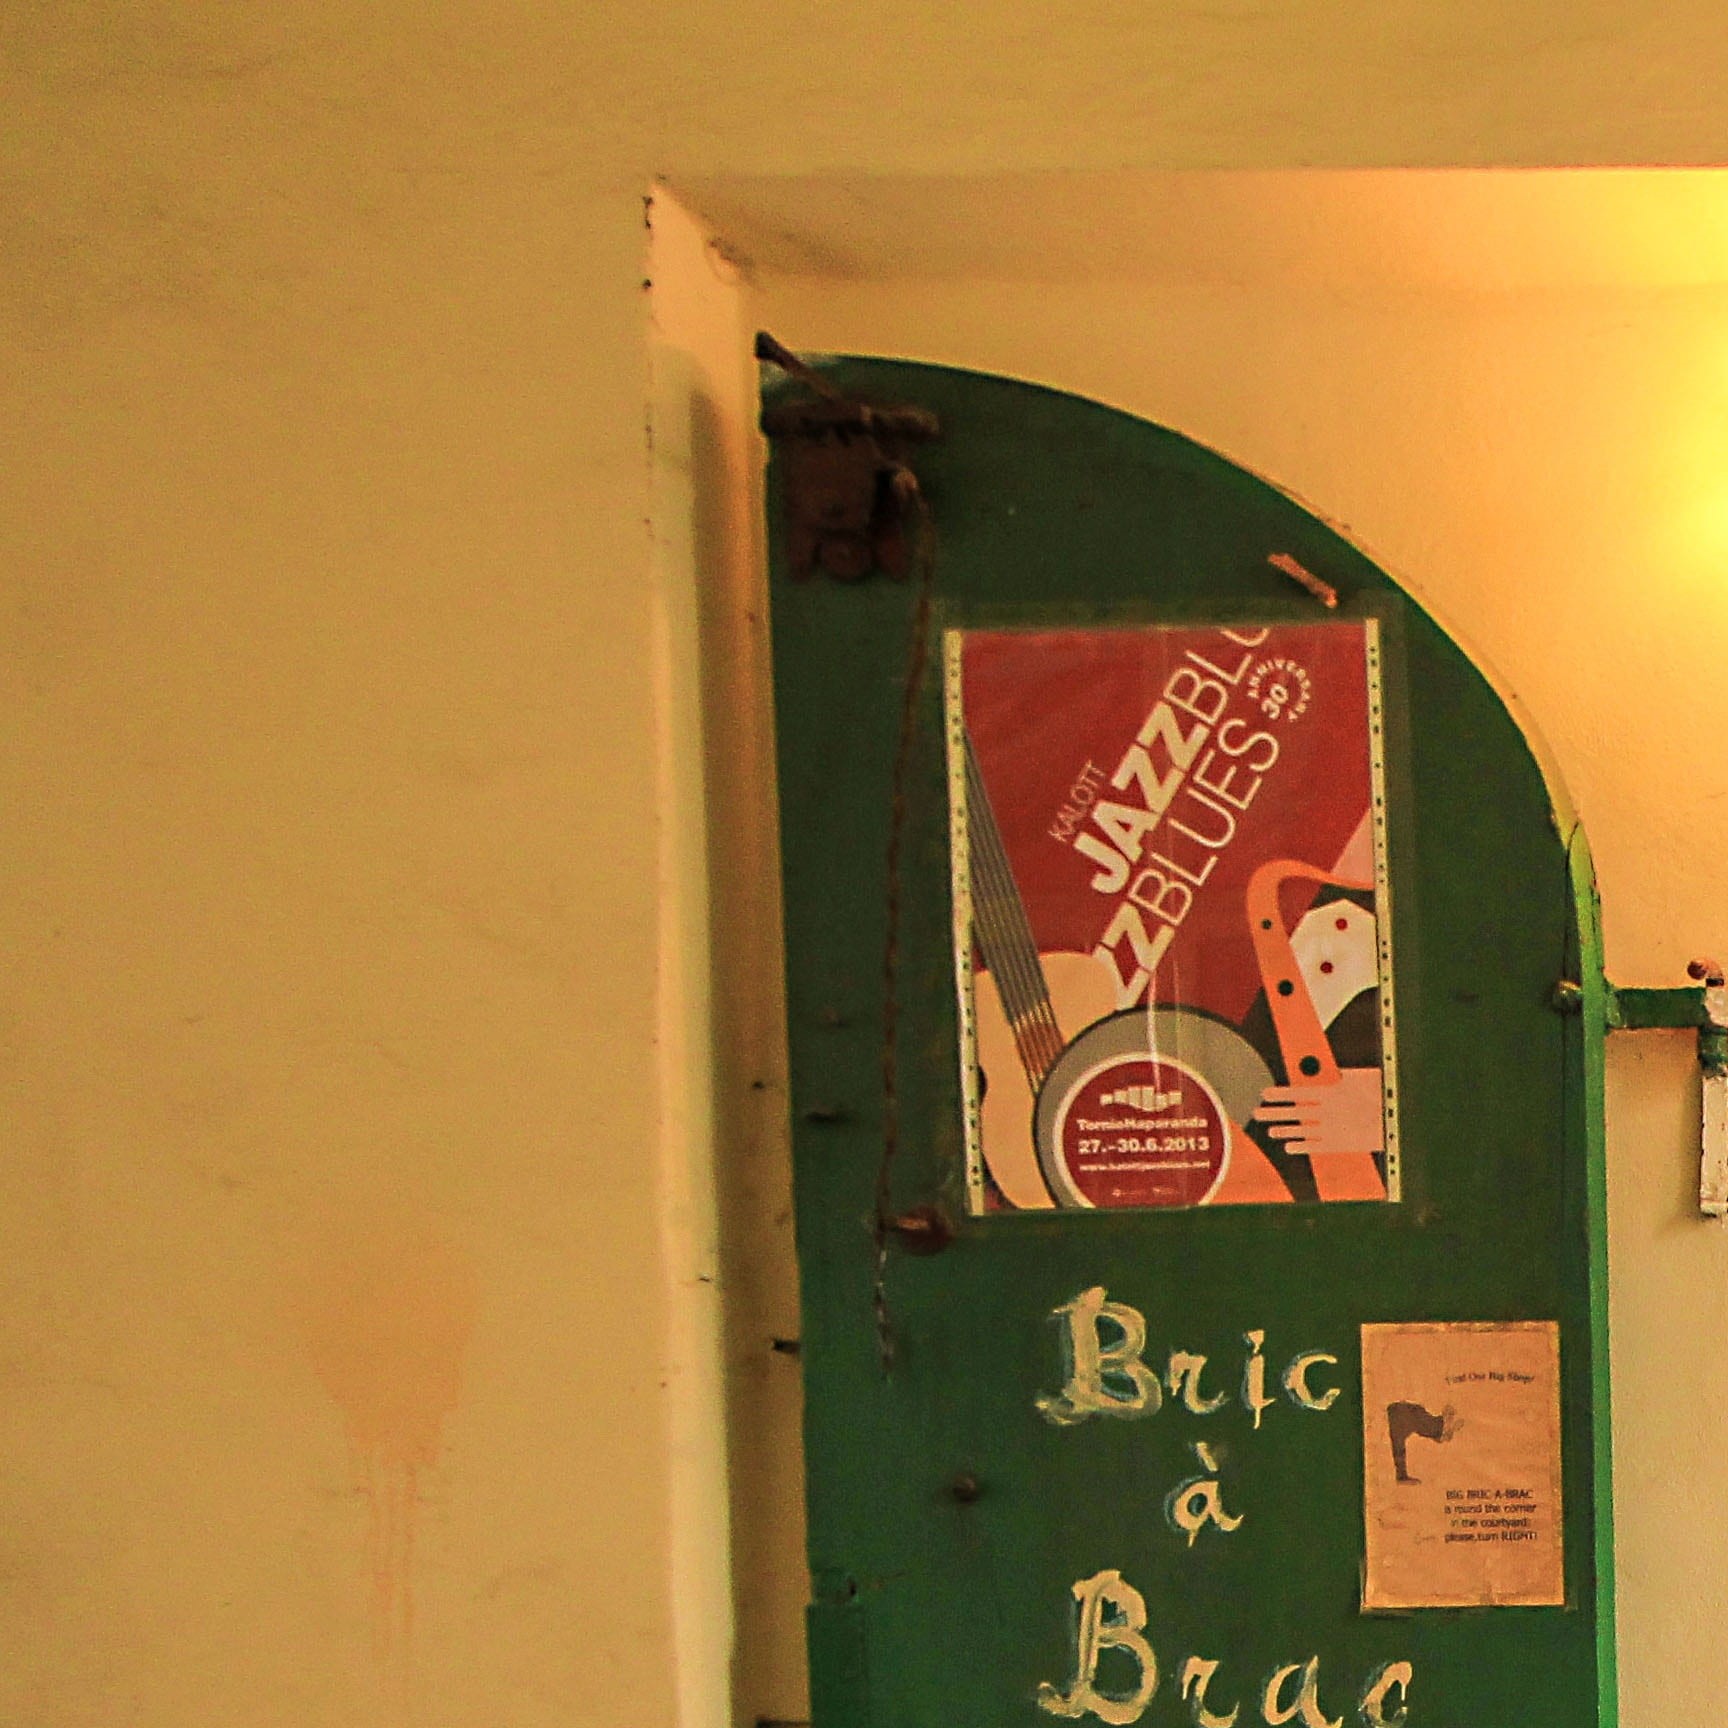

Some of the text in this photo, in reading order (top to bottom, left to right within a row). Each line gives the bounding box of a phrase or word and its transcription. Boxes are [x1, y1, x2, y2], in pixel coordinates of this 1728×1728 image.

[1261, 683, 1289, 720] 30
[1048, 758, 1109, 843] KALOTT
[1078, 1136, 1211, 1154] 27.-30.6.2013
[1035, 1285, 1342, 1430] Bric
